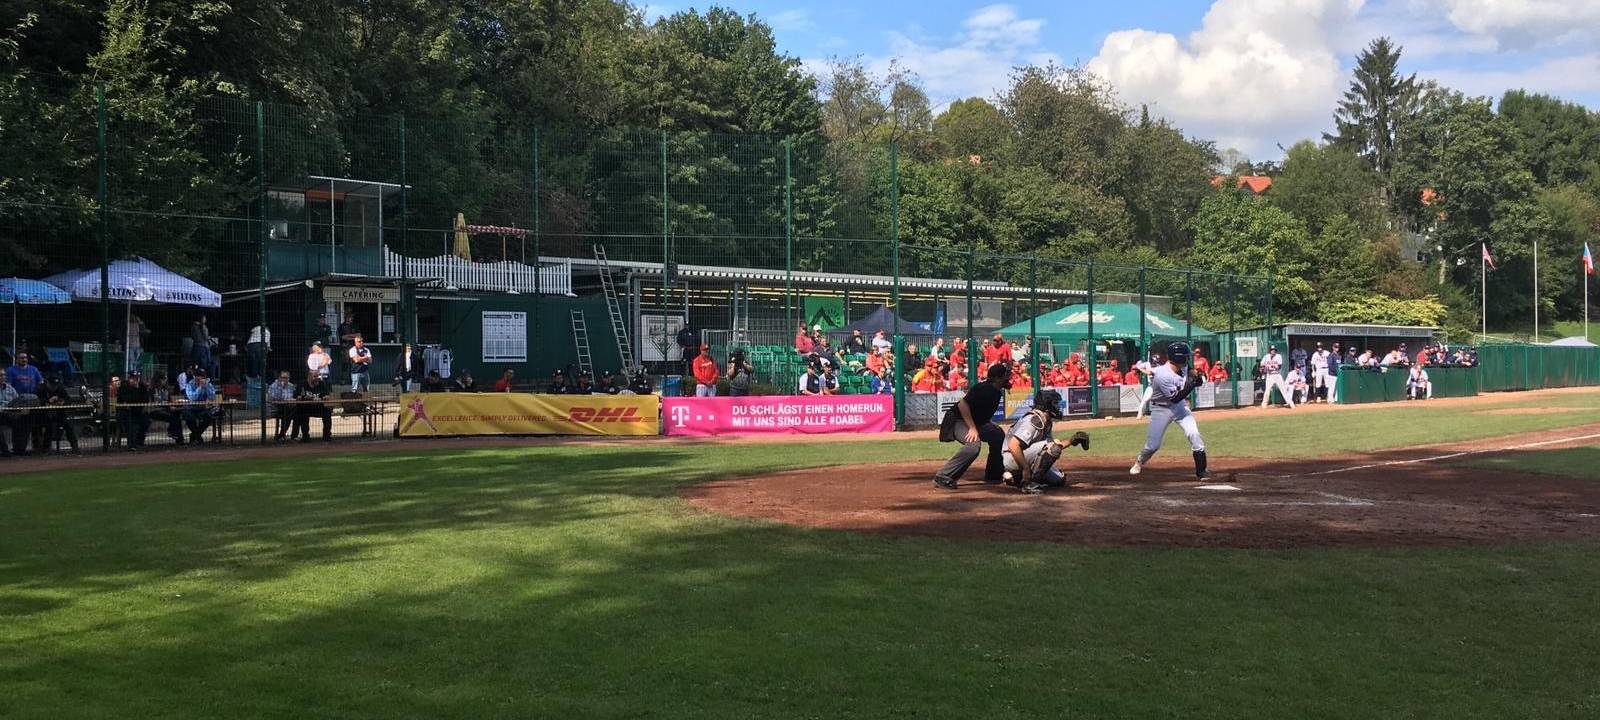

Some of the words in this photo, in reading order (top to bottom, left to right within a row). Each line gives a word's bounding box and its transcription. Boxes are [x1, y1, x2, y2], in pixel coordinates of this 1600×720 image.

[107, 287, 137, 298] ELTINS
[172, 291, 202, 302] VELTINS
[342, 290, 385, 299] CATERING
[569, 407, 641, 422] DHL
[732, 405, 747, 415] DU
[750, 403, 803, 415] SCHLÄGST
[805, 404, 834, 414] EINEN
[836, 403, 886, 413] HOMERUN.
[671, 405, 690, 427] T
[732, 417, 751, 427] MIT
[754, 416, 775, 426] UNS
[777, 416, 802, 426] SIND
[803, 416, 827, 425] ALLE
[829, 415, 867, 425] #DABEI.
